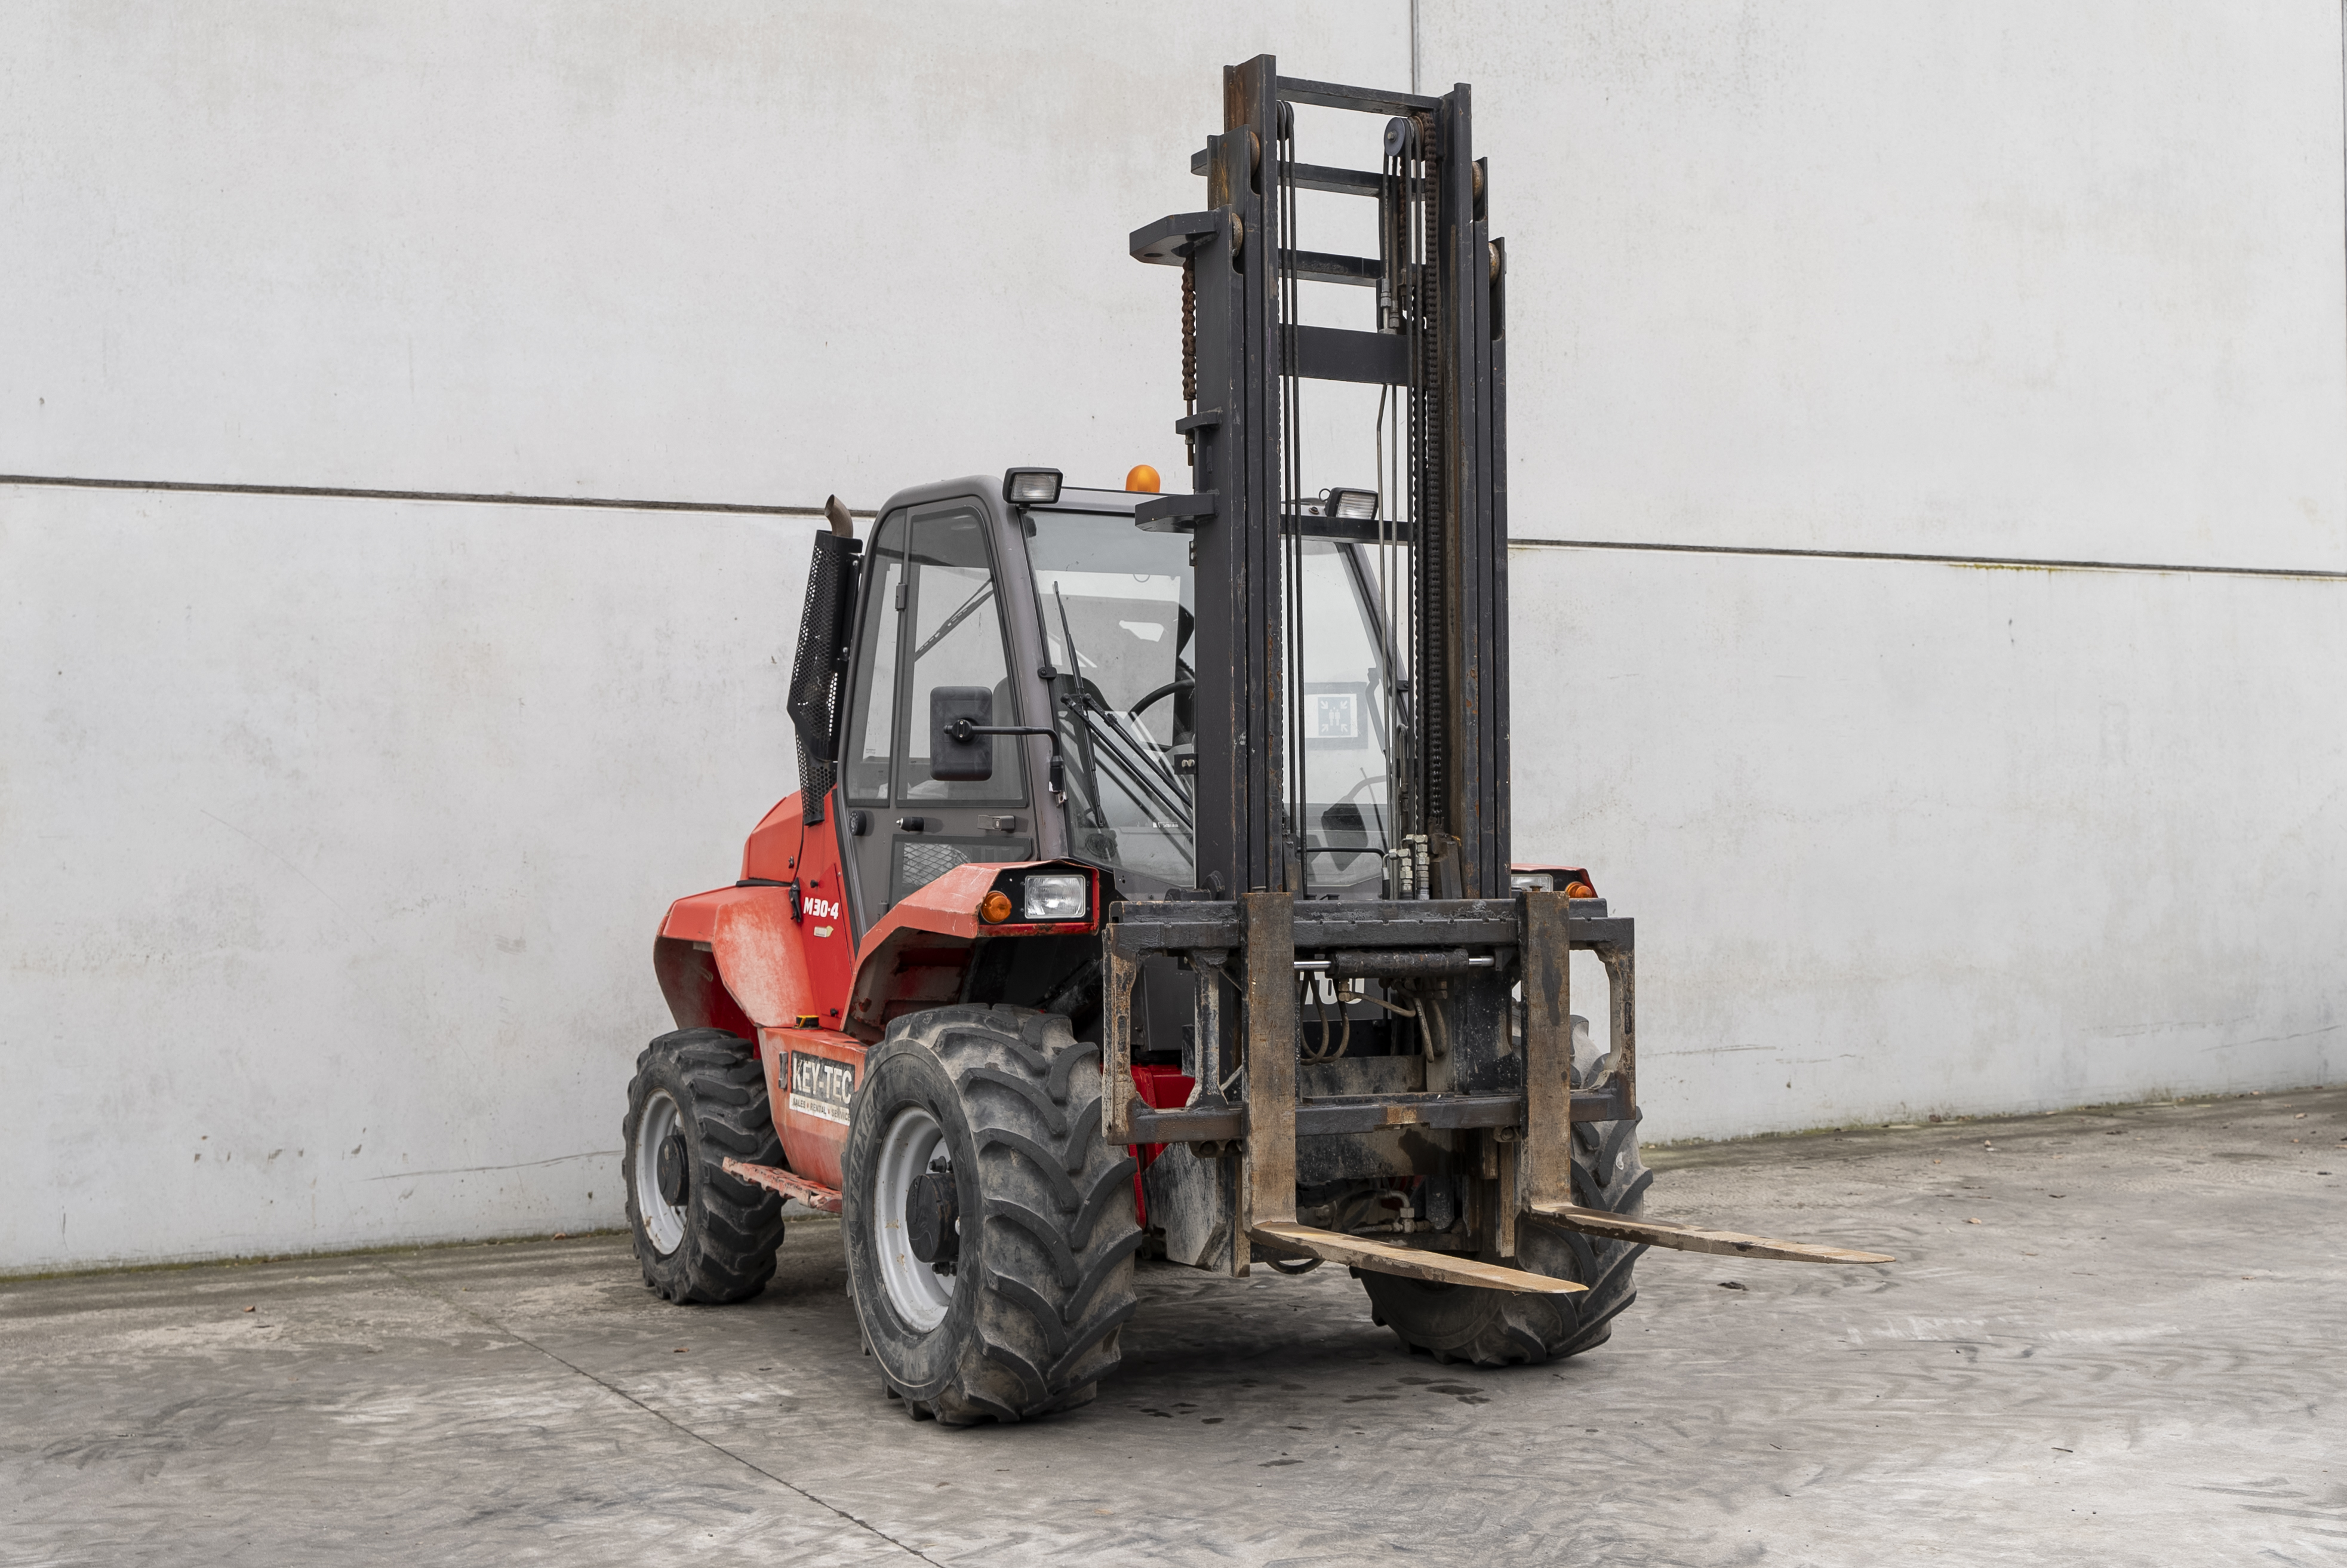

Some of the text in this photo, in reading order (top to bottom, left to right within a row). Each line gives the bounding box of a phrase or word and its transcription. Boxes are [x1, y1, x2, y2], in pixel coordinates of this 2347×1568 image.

[792, 1057, 852, 1104] KEY-TEC
[793, 1097, 805, 1109] SALES
[810, 1103, 826, 1115] RENTAL
